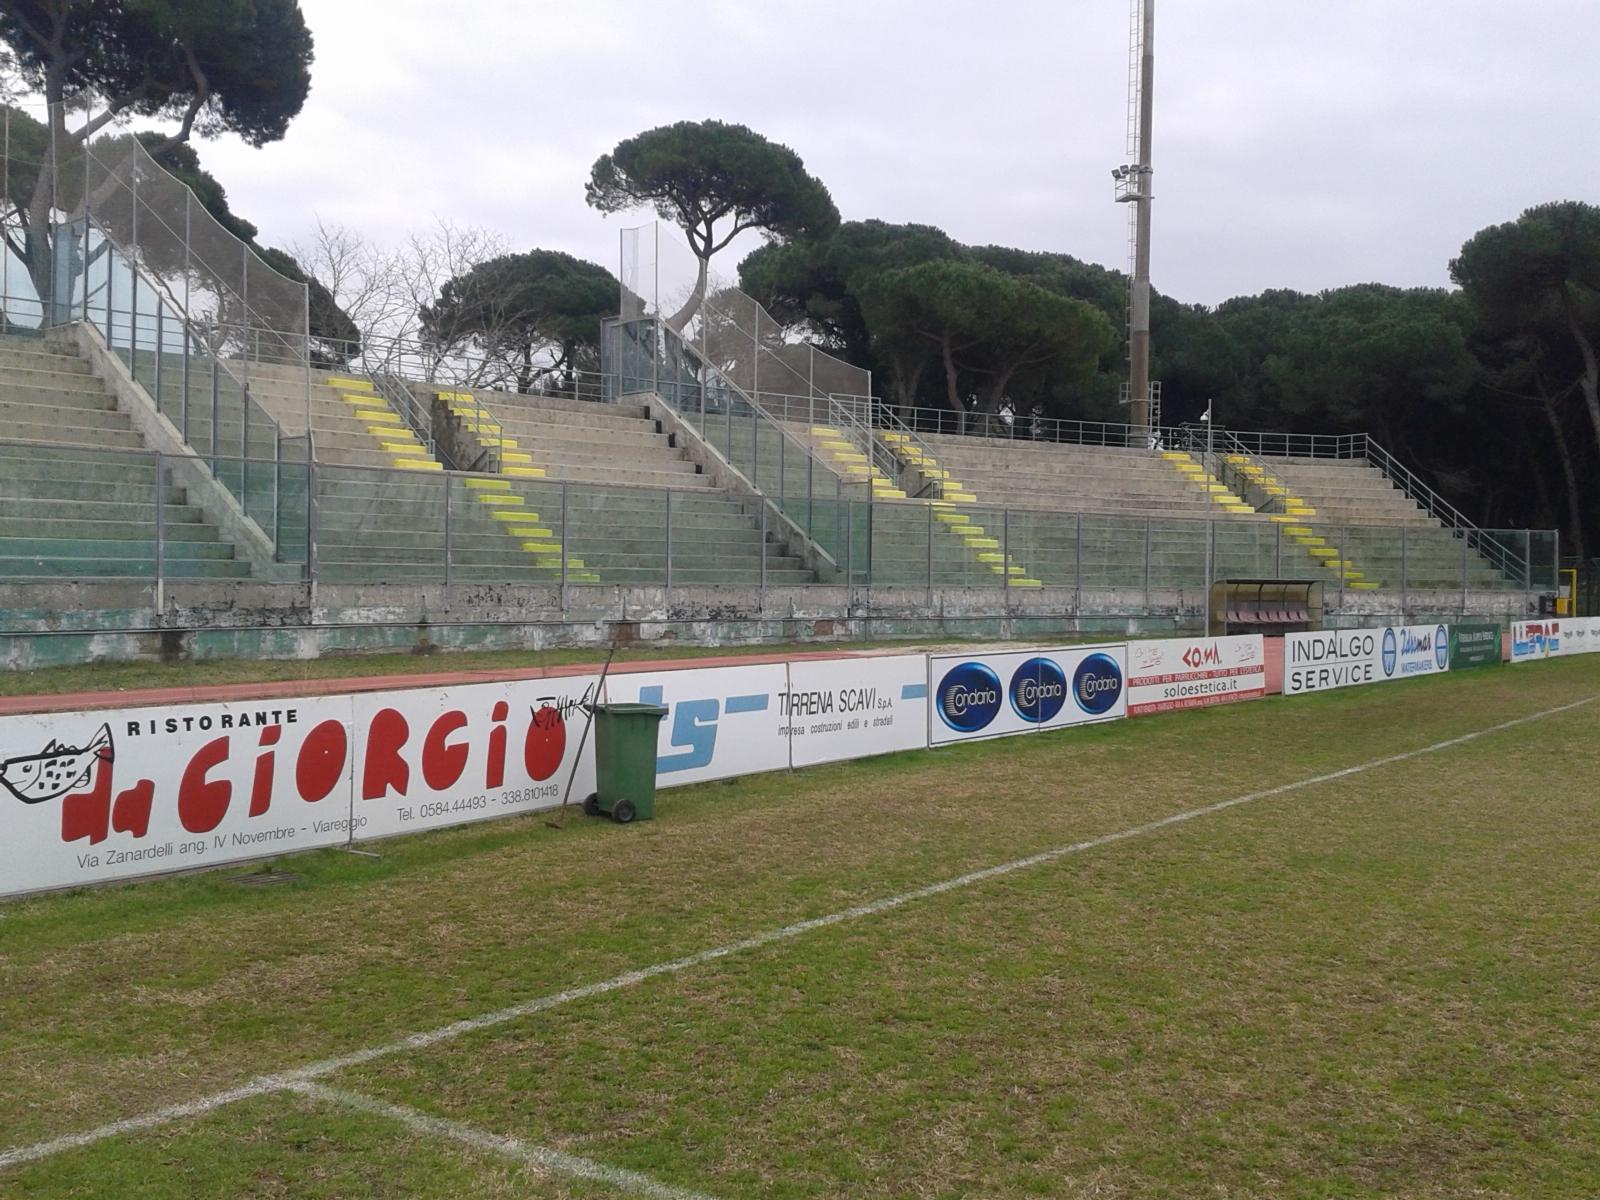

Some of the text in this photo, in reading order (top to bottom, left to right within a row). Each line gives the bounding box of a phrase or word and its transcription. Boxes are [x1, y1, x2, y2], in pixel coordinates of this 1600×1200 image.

[1292, 635, 1375, 662] INDALGO
[1162, 674, 1172, 683] PER
[1163, 679, 1238, 698] soloestetica.it
[1291, 663, 1373, 691] SERVICE
[778, 690, 833, 716] TIRRENA
[838, 688, 876, 712] SCAVI
[127, 709, 298, 736] RISTORANTE
[810, 720, 843, 734] costruzioni
[847, 718, 860, 730] edili
[864, 719, 869, 728] e
[873, 715, 893, 727] stradali
[397, 807, 415, 822] Tel.
[420, 795, 487, 818] 0584.44493
[501, 783, 559, 805] 338.8101418
[77, 854, 99, 869] Via
[106, 841, 174, 865] Zanardelli
[179, 840, 208, 855] ang.
[214, 834, 227, 849] IV
[232, 825, 296, 846] Novembre
[313, 814, 368, 834] Viareggio
